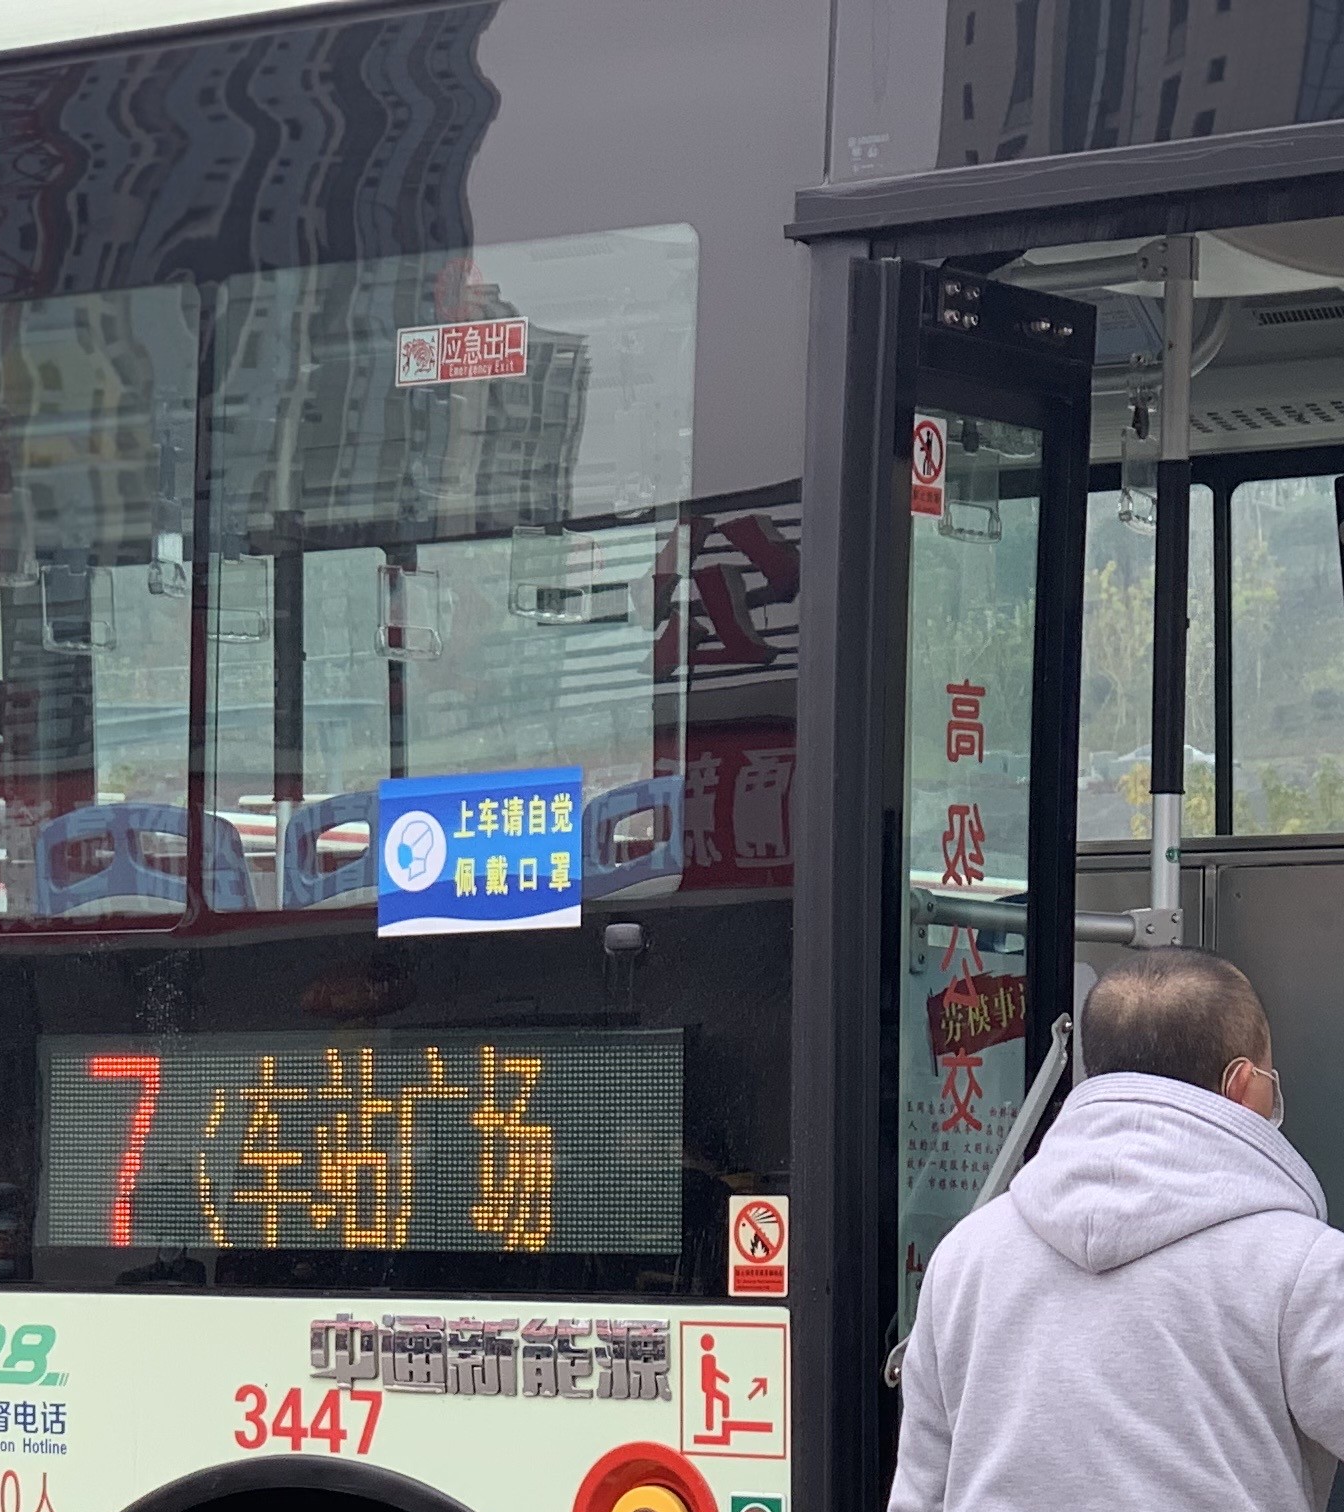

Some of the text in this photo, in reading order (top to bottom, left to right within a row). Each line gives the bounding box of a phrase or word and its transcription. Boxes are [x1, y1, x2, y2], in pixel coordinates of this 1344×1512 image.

[441, 323, 525, 365] 应急出口
[449, 360, 515, 378] Emergency Exit
[453, 792, 573, 839] 上车请自觉
[454, 851, 572, 897] 佩戴口罩
[940, 982, 1026, 1047] 劳模事
[89, 1054, 159, 1248] 7
[234, 1384, 384, 1455] 3447
[22, 1437, 68, 1456] Hotline
